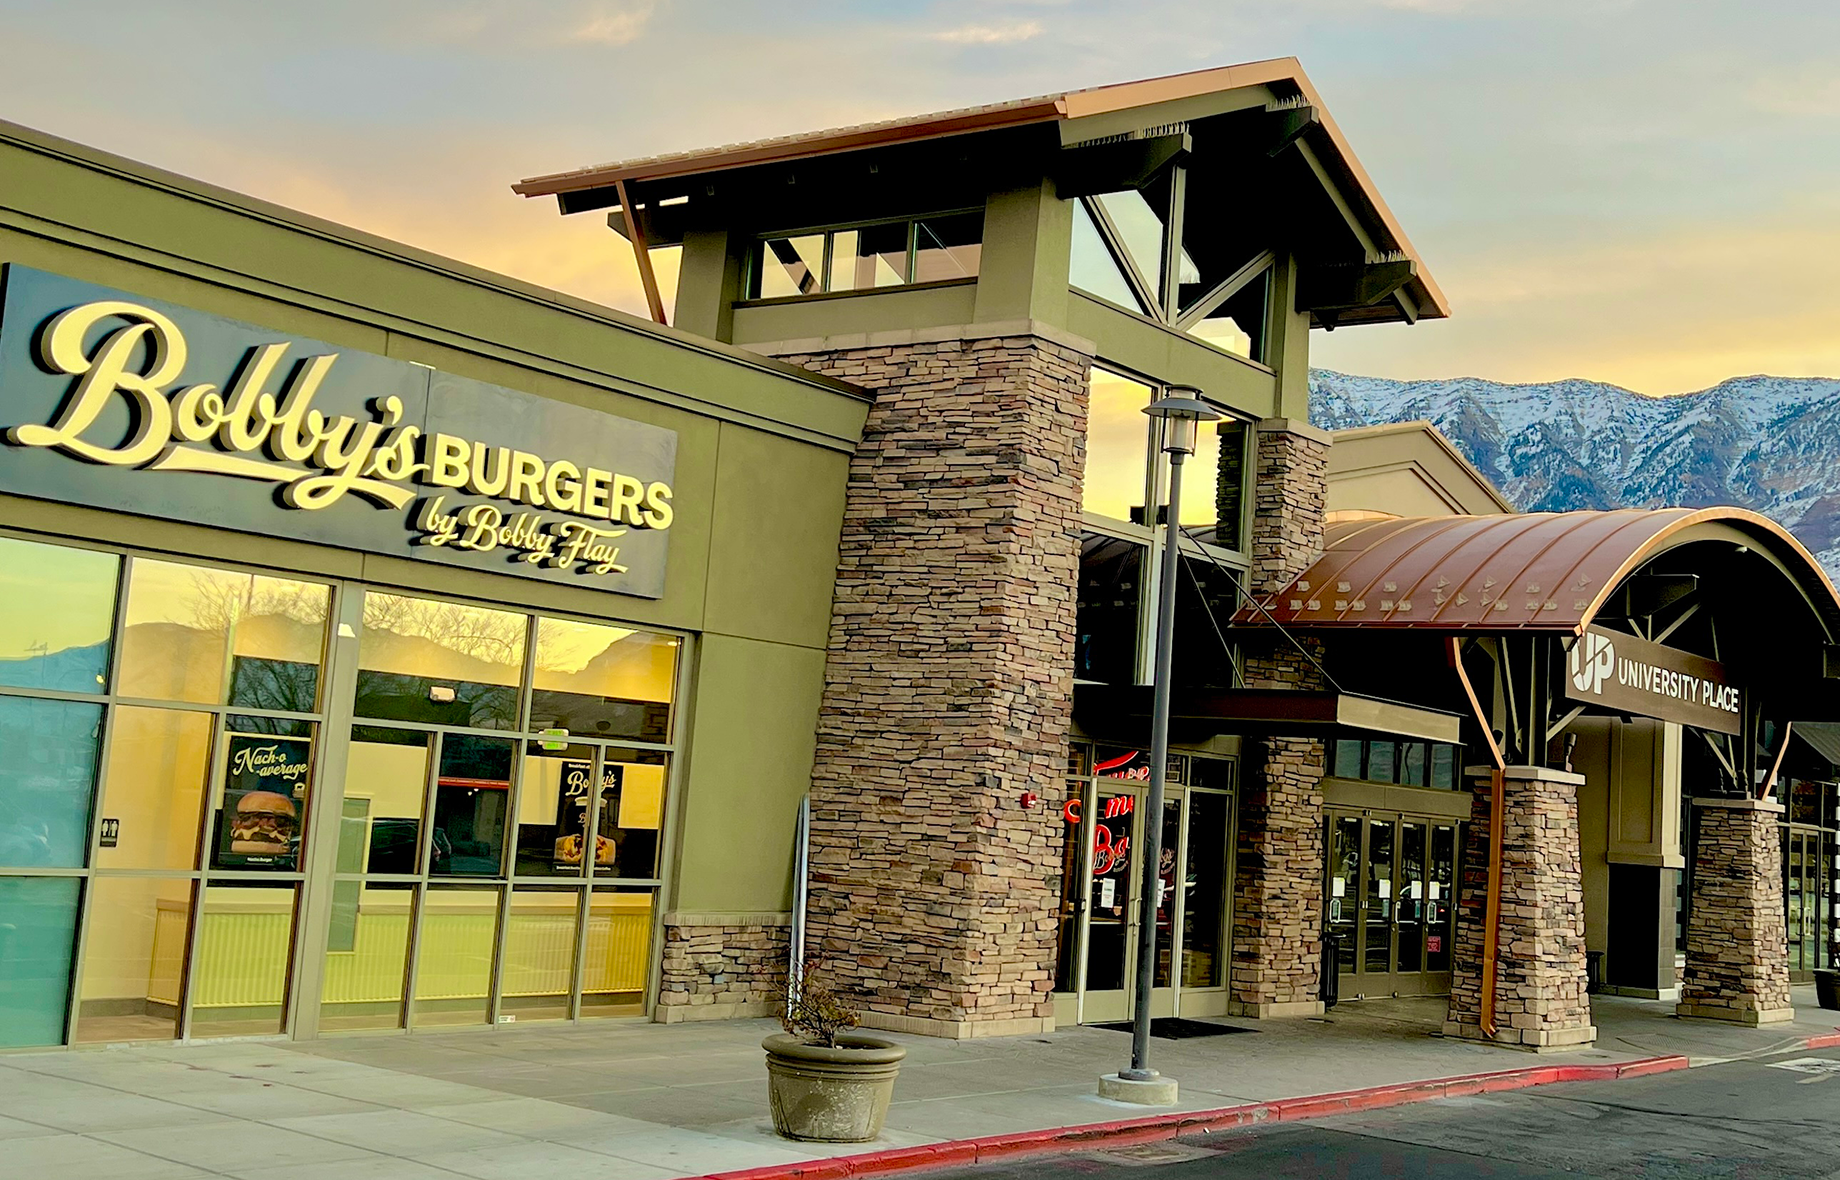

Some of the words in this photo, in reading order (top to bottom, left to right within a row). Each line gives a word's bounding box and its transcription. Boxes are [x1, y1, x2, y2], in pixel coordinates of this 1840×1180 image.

[16, 301, 430, 510] Bobby's
[432, 432, 674, 530] BURGERS
[426, 495, 458, 546] by
[460, 504, 555, 563] Bobby
[558, 521, 628, 575] Flay
[1571, 632, 1615, 694] UP
[1618, 657, 1699, 702] UNIVERSITY
[1702, 681, 1738, 712] PLACE
[565, 770, 616, 796] Boy's
